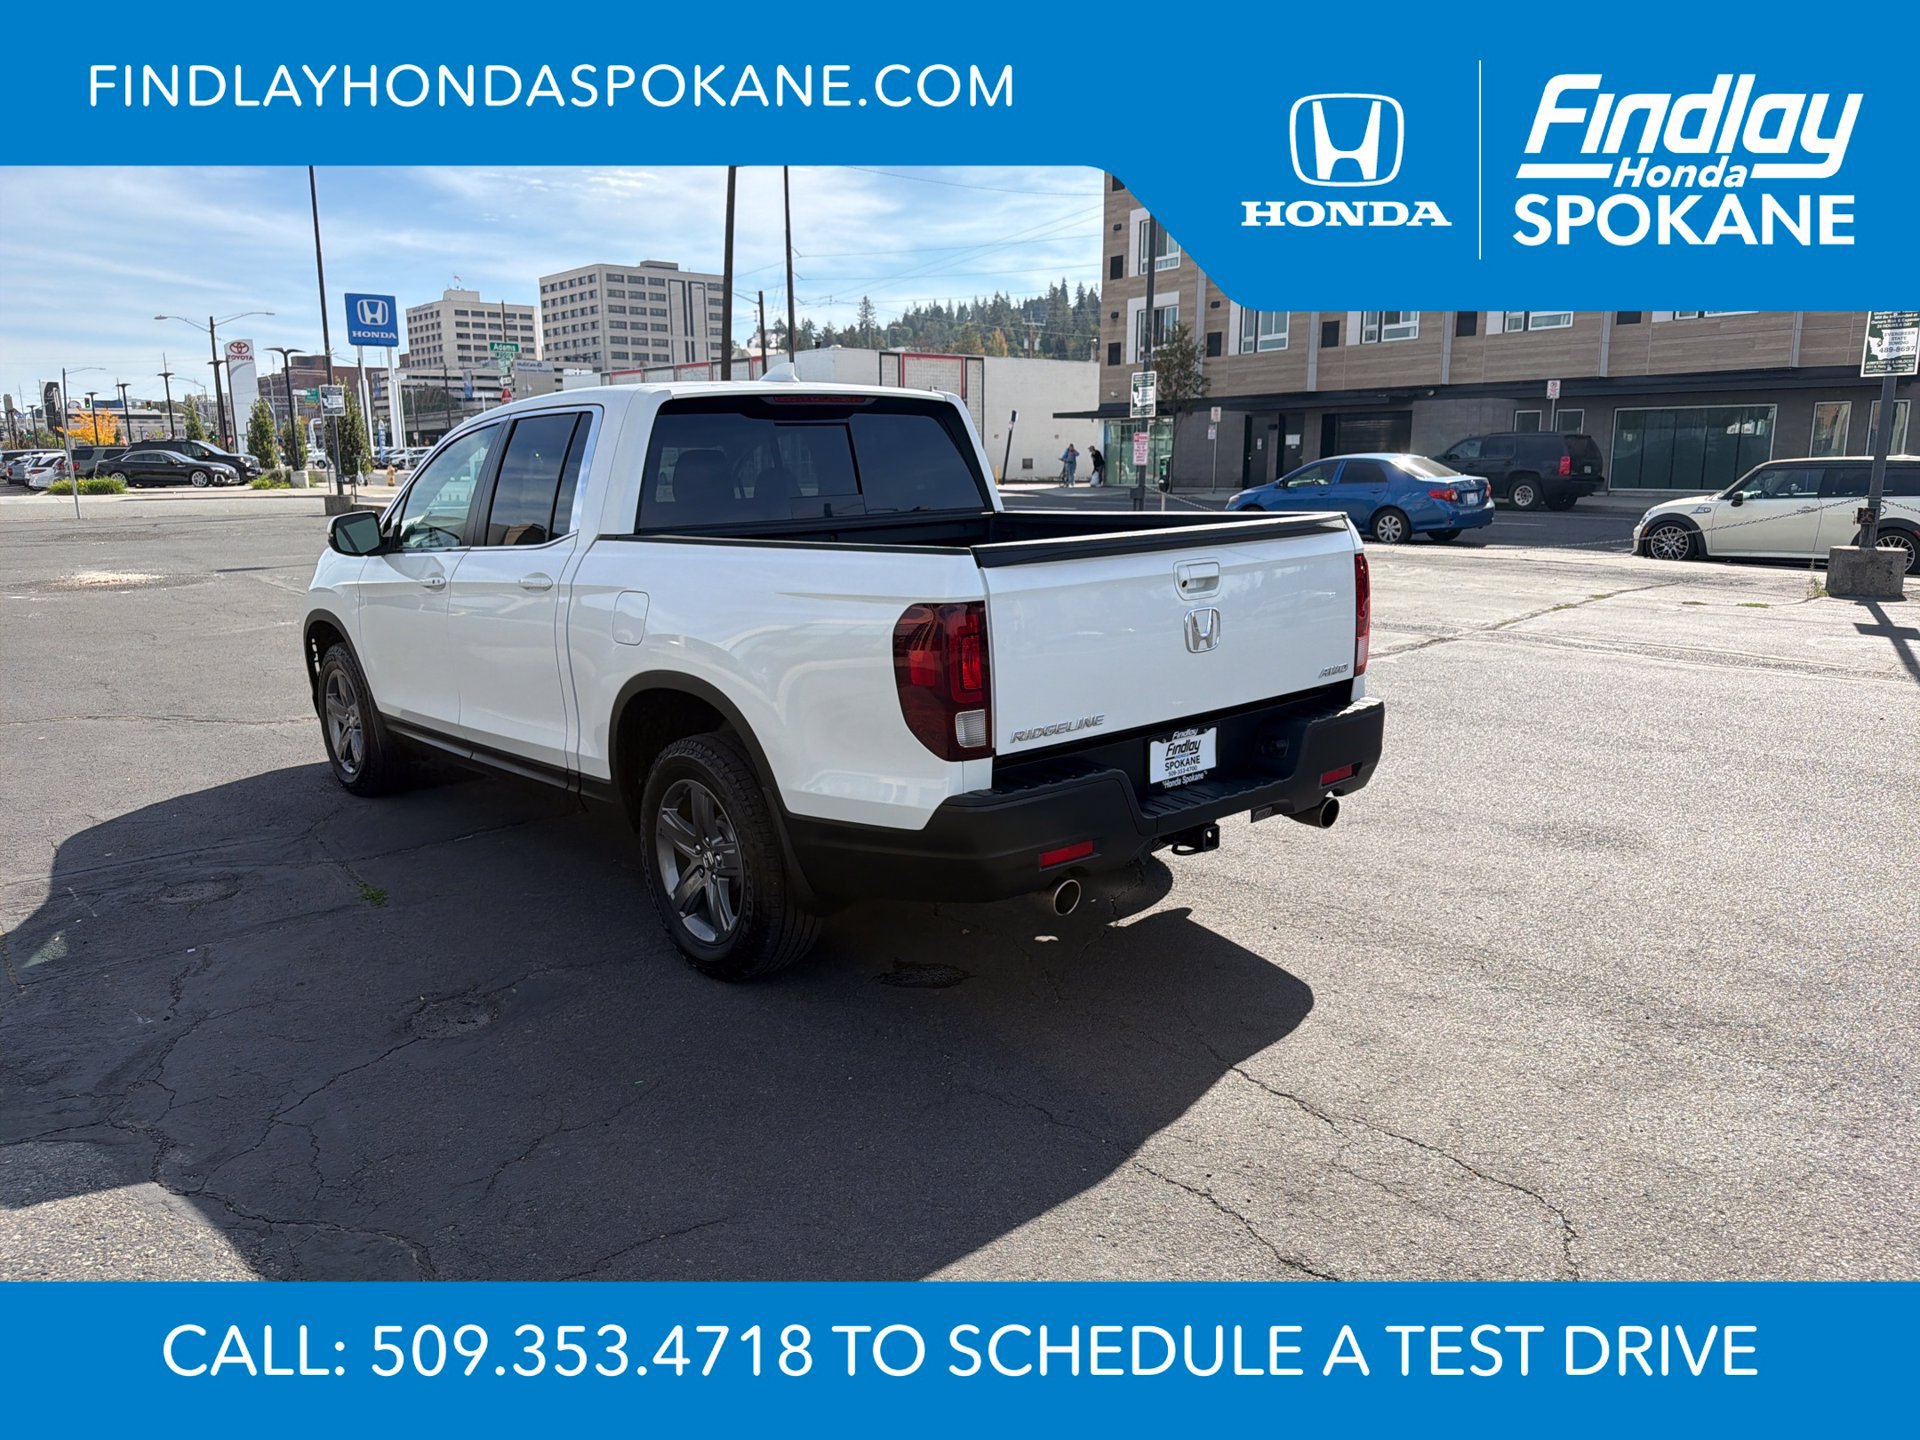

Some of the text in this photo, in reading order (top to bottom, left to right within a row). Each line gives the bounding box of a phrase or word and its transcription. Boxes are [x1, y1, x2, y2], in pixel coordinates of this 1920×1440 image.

[352, 331, 397, 339] HONDA
[493, 343, 516, 351] Adams
[1318, 663, 1348, 679] AWD
[1010, 714, 1105, 744] RIDGELINE
[1172, 728, 1199, 740] Findlay
[1166, 739, 1201, 757] Findlay
[1165, 755, 1201, 771] SPOKANE
[1168, 765, 1198, 777] 509-353-4700
[1164, 773, 1204, 789] Honda Spokane
